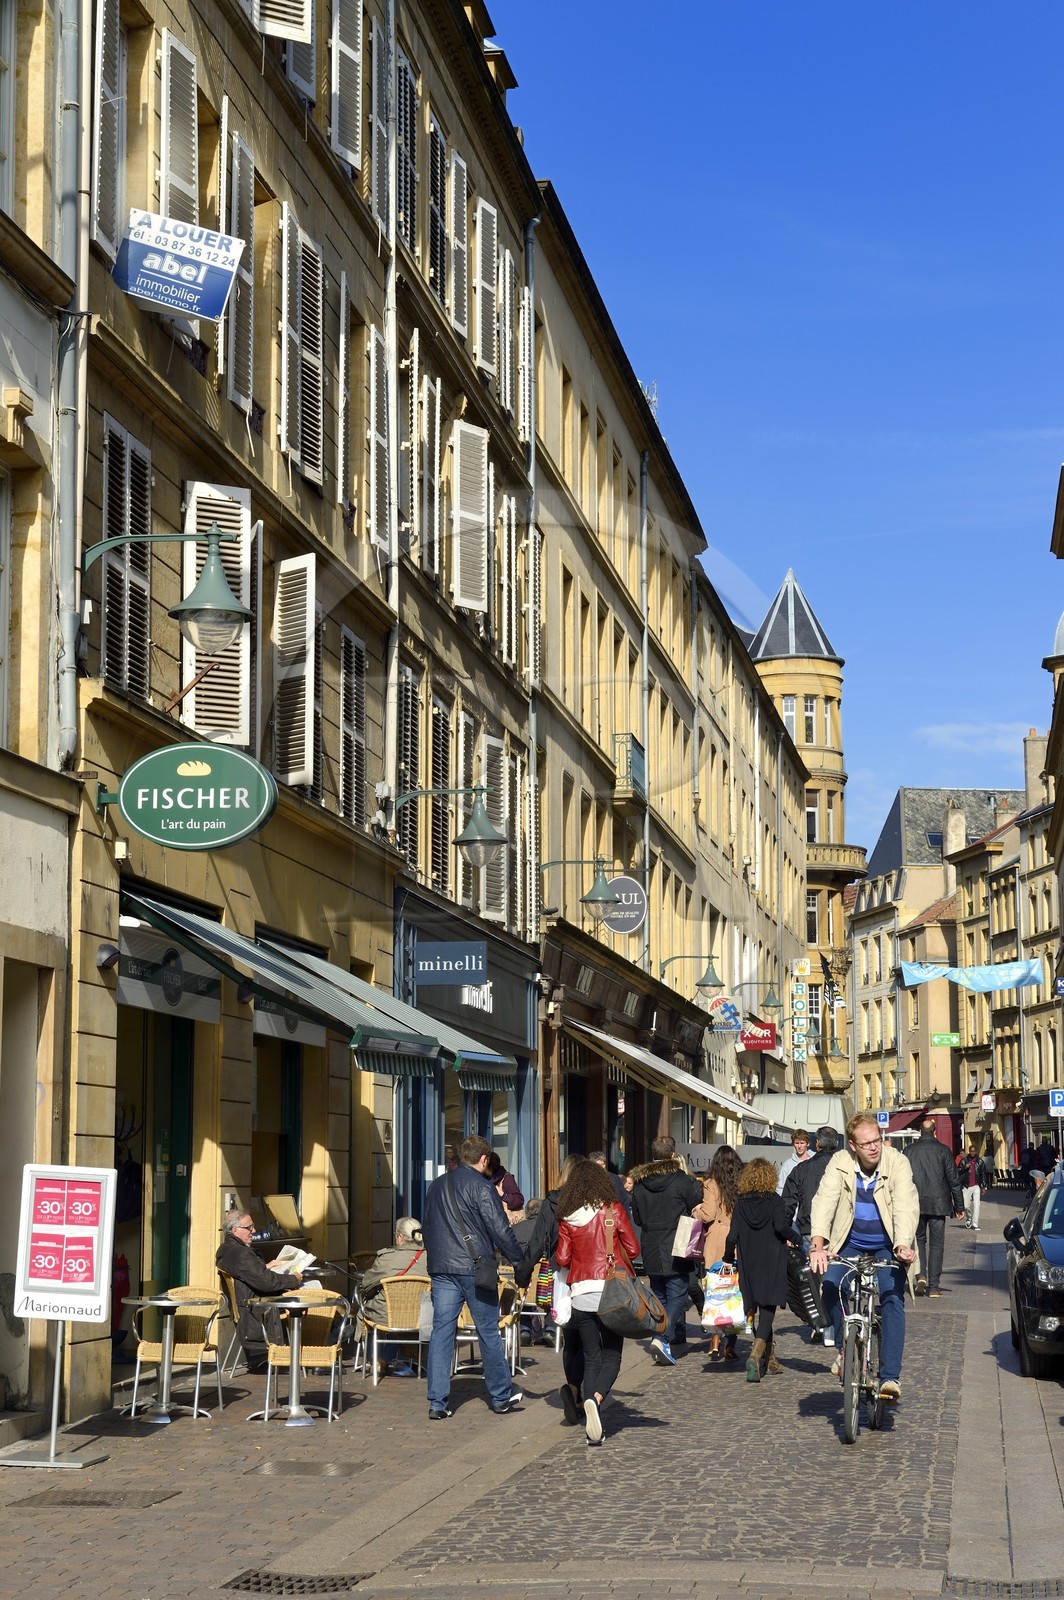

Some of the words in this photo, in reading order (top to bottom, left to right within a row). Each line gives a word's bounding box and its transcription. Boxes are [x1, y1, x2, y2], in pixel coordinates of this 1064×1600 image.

[137, 213, 152, 229] A
[160, 218, 233, 253] LOUER
[154, 235, 168, 247] 03
[171, 240, 186, 252] 87
[188, 245, 202, 257] 36
[206, 251, 219, 263] 12
[221, 256, 236, 268] 24
[142, 252, 209, 284] abel
[129, 285, 201, 312] abel-immo.fr
[135, 274, 201, 303] immobilier
[137, 787, 250, 809] FISCHER
[161, 819, 184, 830] L'art
[186, 819, 200, 830] du
[203, 819, 226, 832] pain
[418, 955, 484, 971] minelli
[794, 983, 806, 1060] ROLEX
[17, 1295, 102, 1316] Marionnaud
